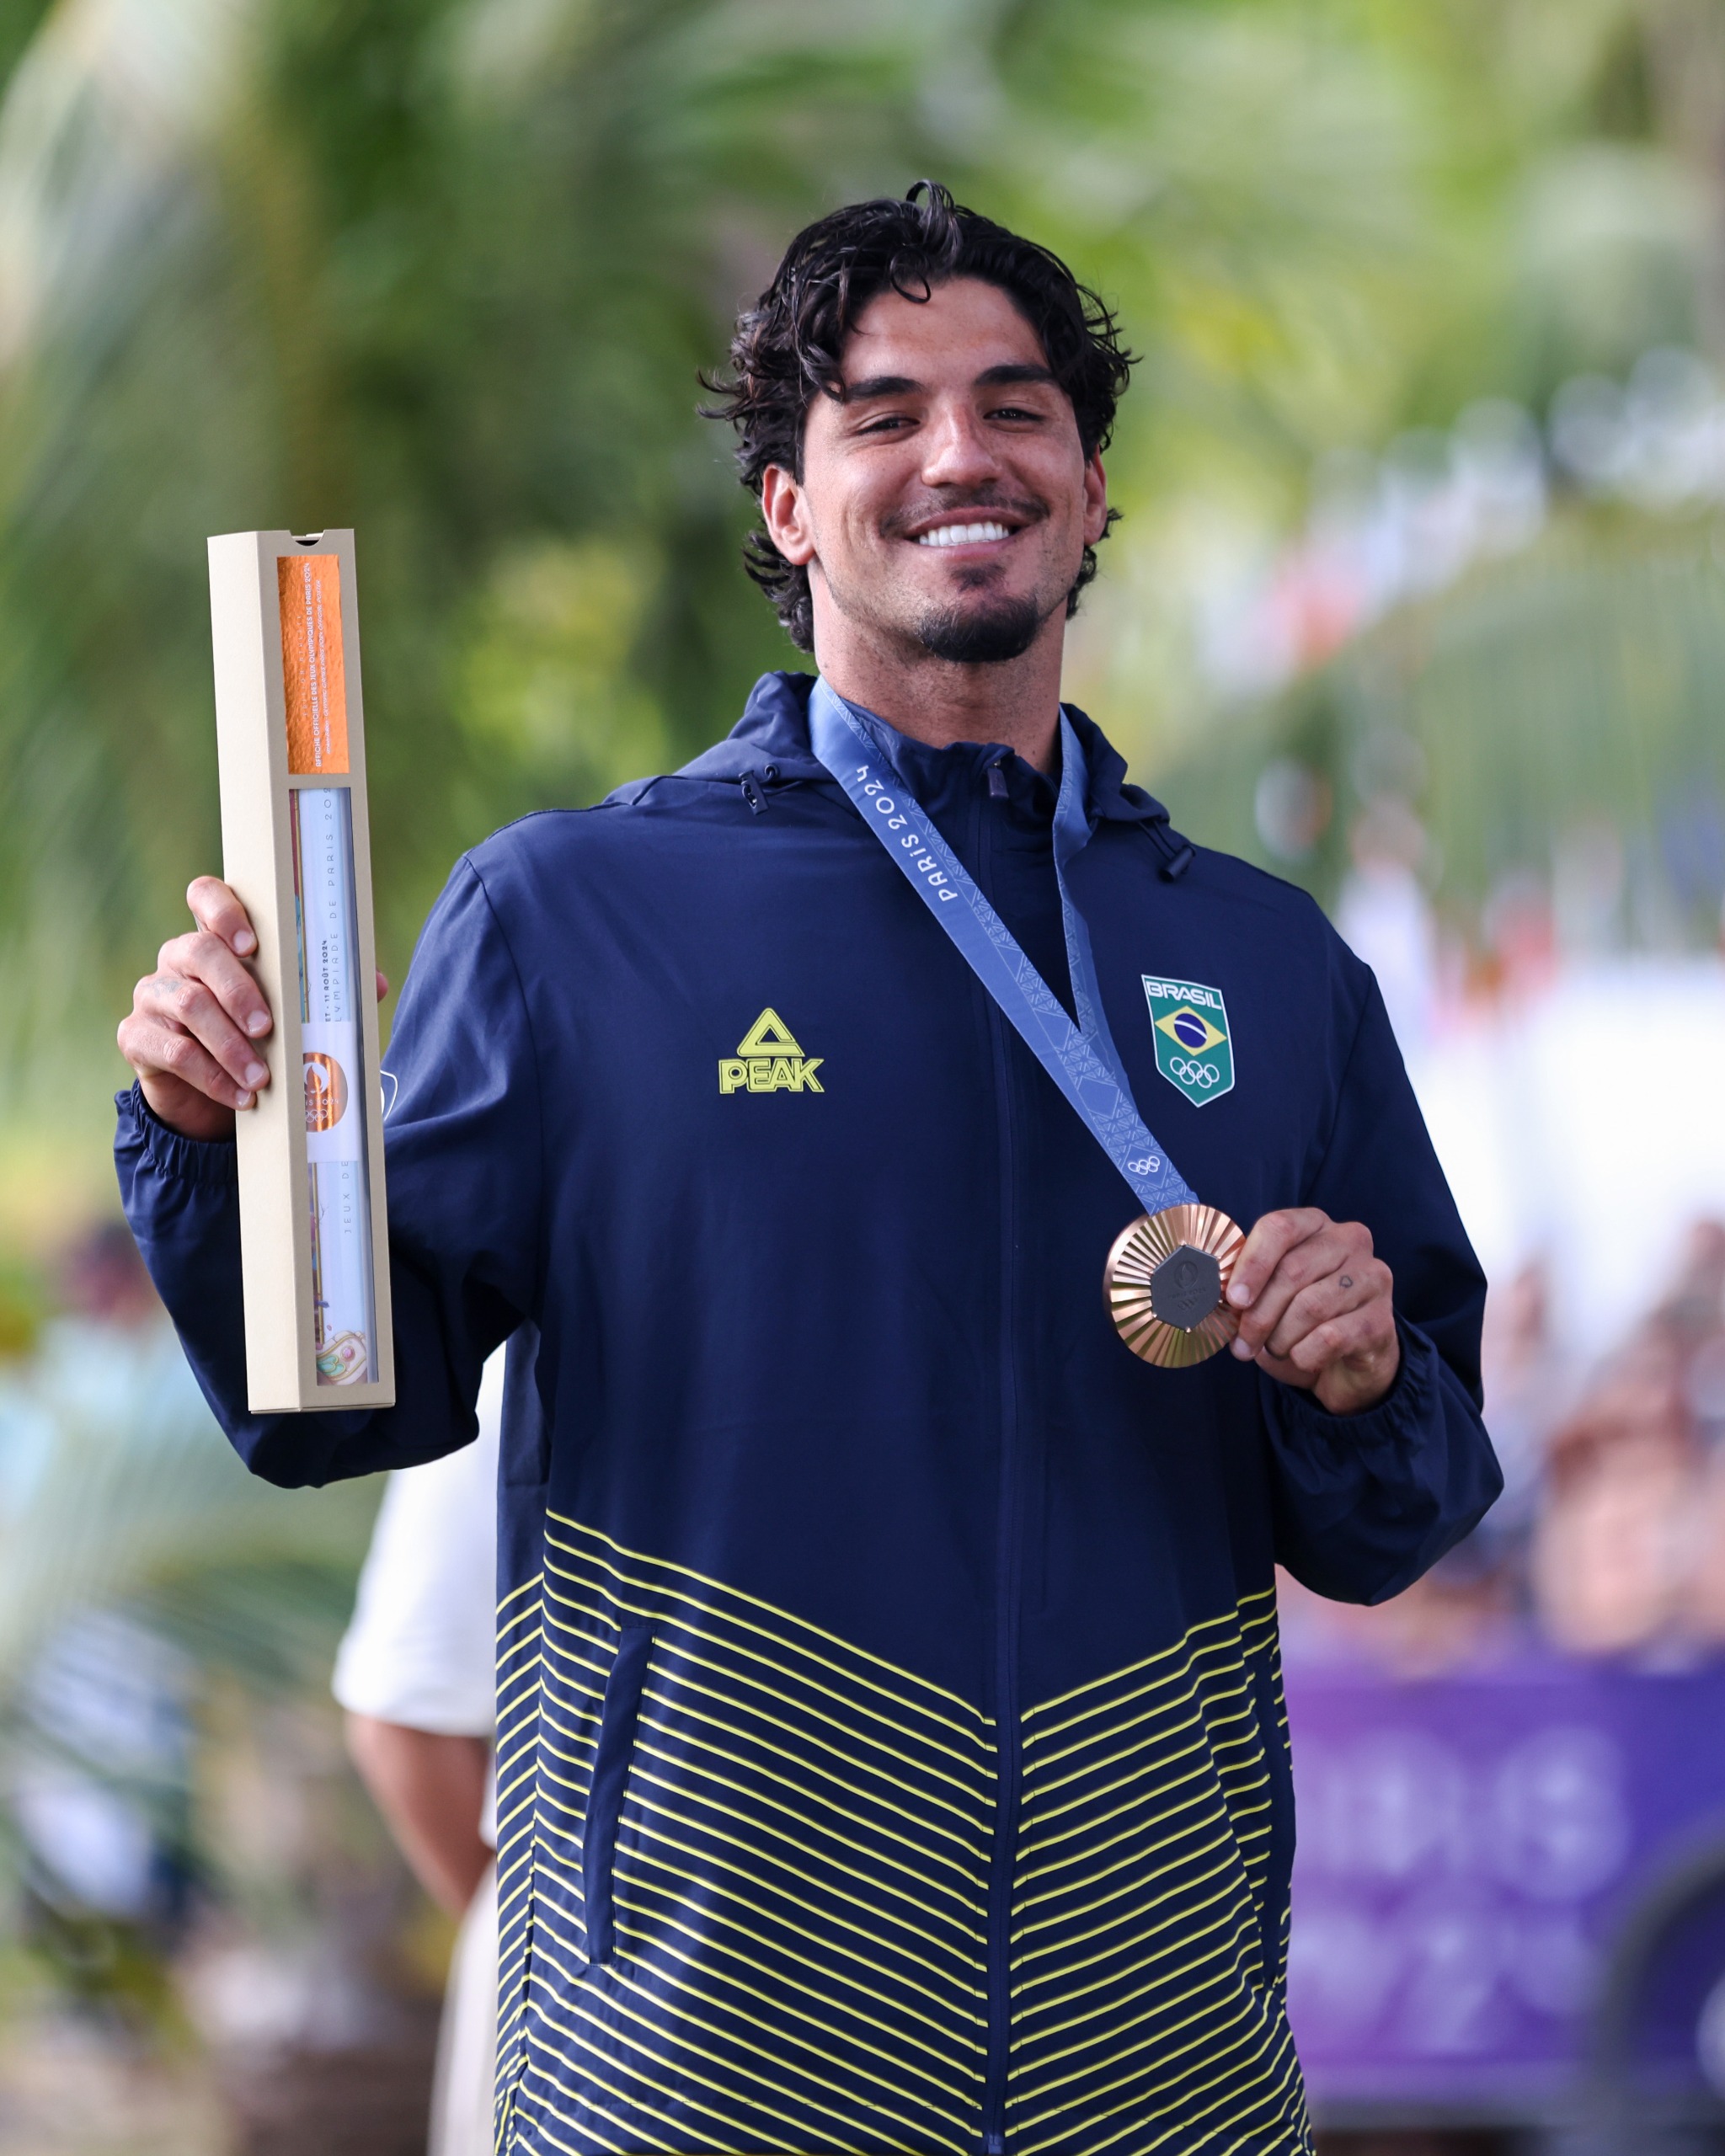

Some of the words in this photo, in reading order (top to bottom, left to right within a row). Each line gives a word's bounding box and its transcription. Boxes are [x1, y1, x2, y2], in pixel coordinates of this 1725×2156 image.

[306, 606, 312, 615] DE
[307, 616, 315, 663] OLYMPIQUES
[323, 788, 332, 820] 202
[856, 765, 908, 830] 2024
[325, 835, 334, 886] PARIS
[329, 901, 337, 919] DE
[330, 933, 341, 1022] LYMPIADE
[1146, 981, 1222, 1010] BRASIL
[324, 995, 330, 1003] 11
[718, 1057, 825, 1094] PEAK
[343, 1193, 351, 1234] JEUX
